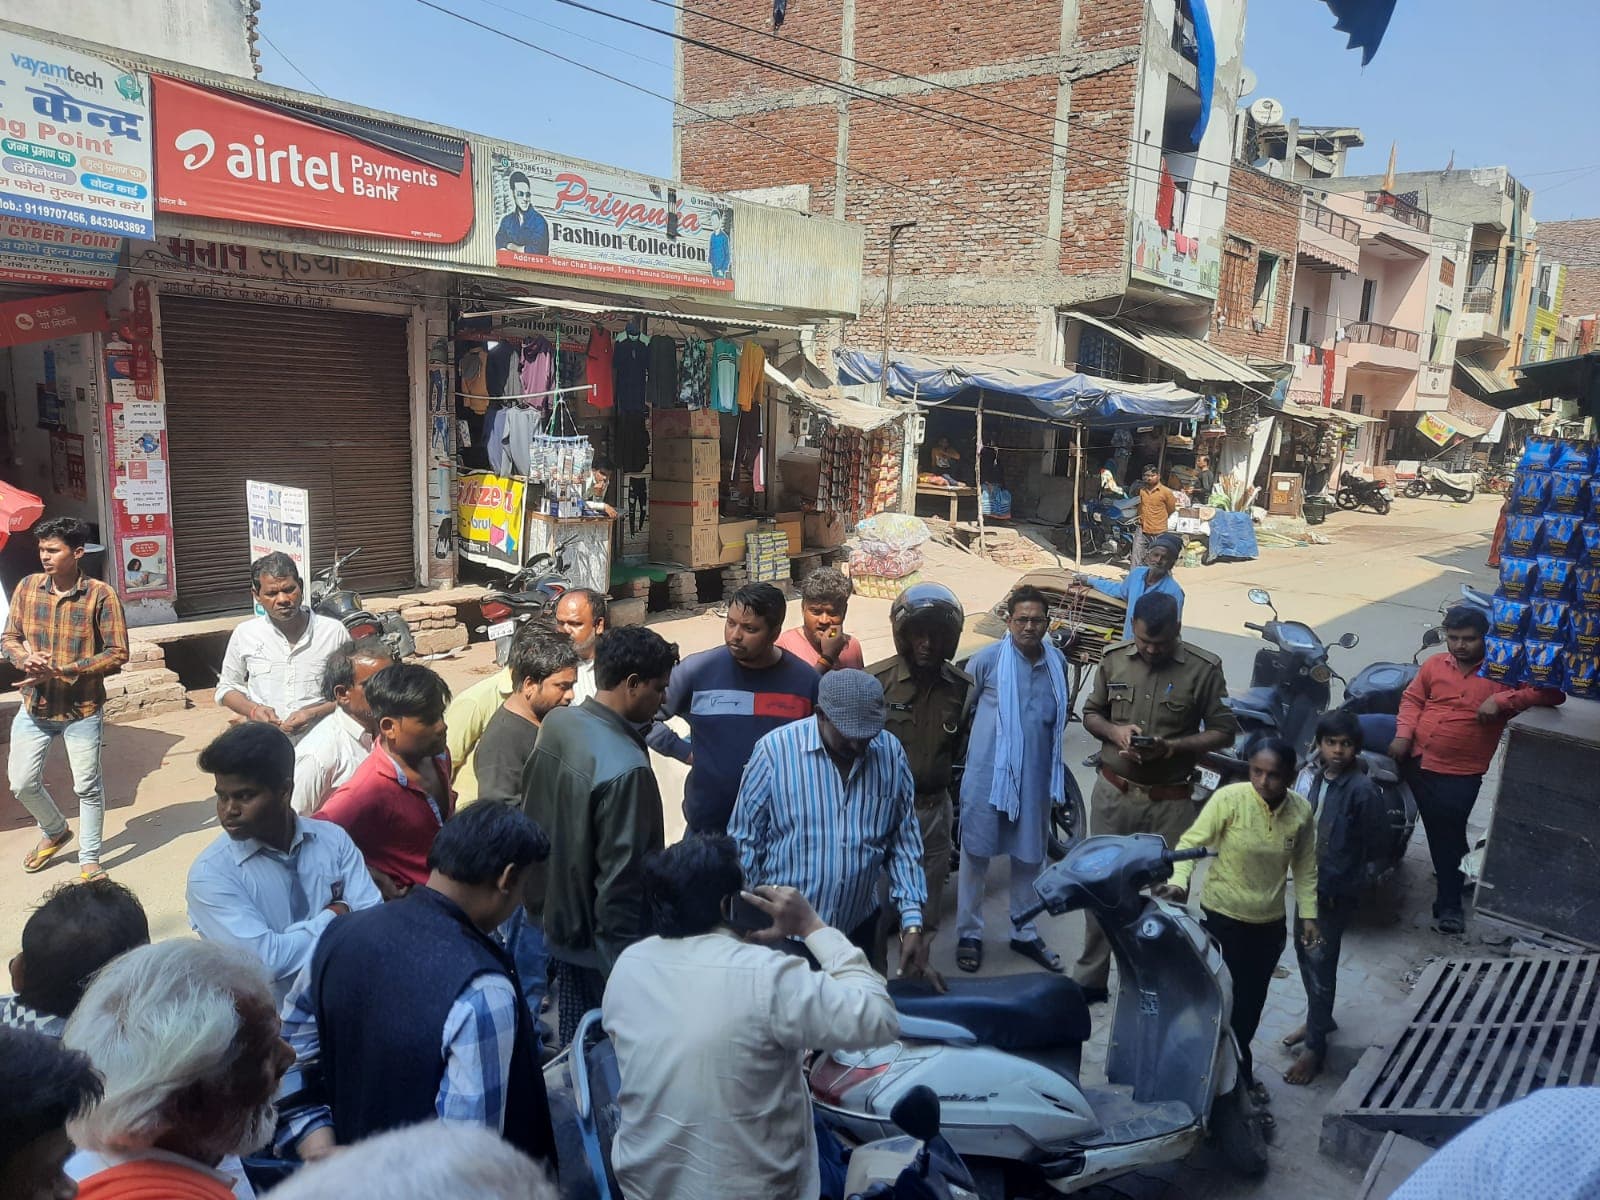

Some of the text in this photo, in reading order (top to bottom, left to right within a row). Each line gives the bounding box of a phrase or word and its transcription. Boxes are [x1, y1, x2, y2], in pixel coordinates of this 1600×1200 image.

[11, 52, 103, 89] vayamtech
[25, 82, 144, 142] केन्द्र
[7, 141, 29, 154] जन्म
[31, 144, 56, 160] प्रमाण
[38, 121, 113, 155] Point
[226, 134, 345, 194] airtel
[351, 155, 439, 188] Payments
[14, 179, 45, 194] फोटो
[50, 185, 84, 201] तुरन्त
[87, 193, 116, 208] प्राप्त
[90, 178, 139, 197] वोटर कार्ड
[8, 224, 120, 250] CYBER POINT
[551, 222, 706, 262] Fashion Collection
[513, 253, 544, 264] Address
[552, 257, 569, 267] Near
[570, 260, 587, 269] Char
[618, 266, 635, 275] Trans
